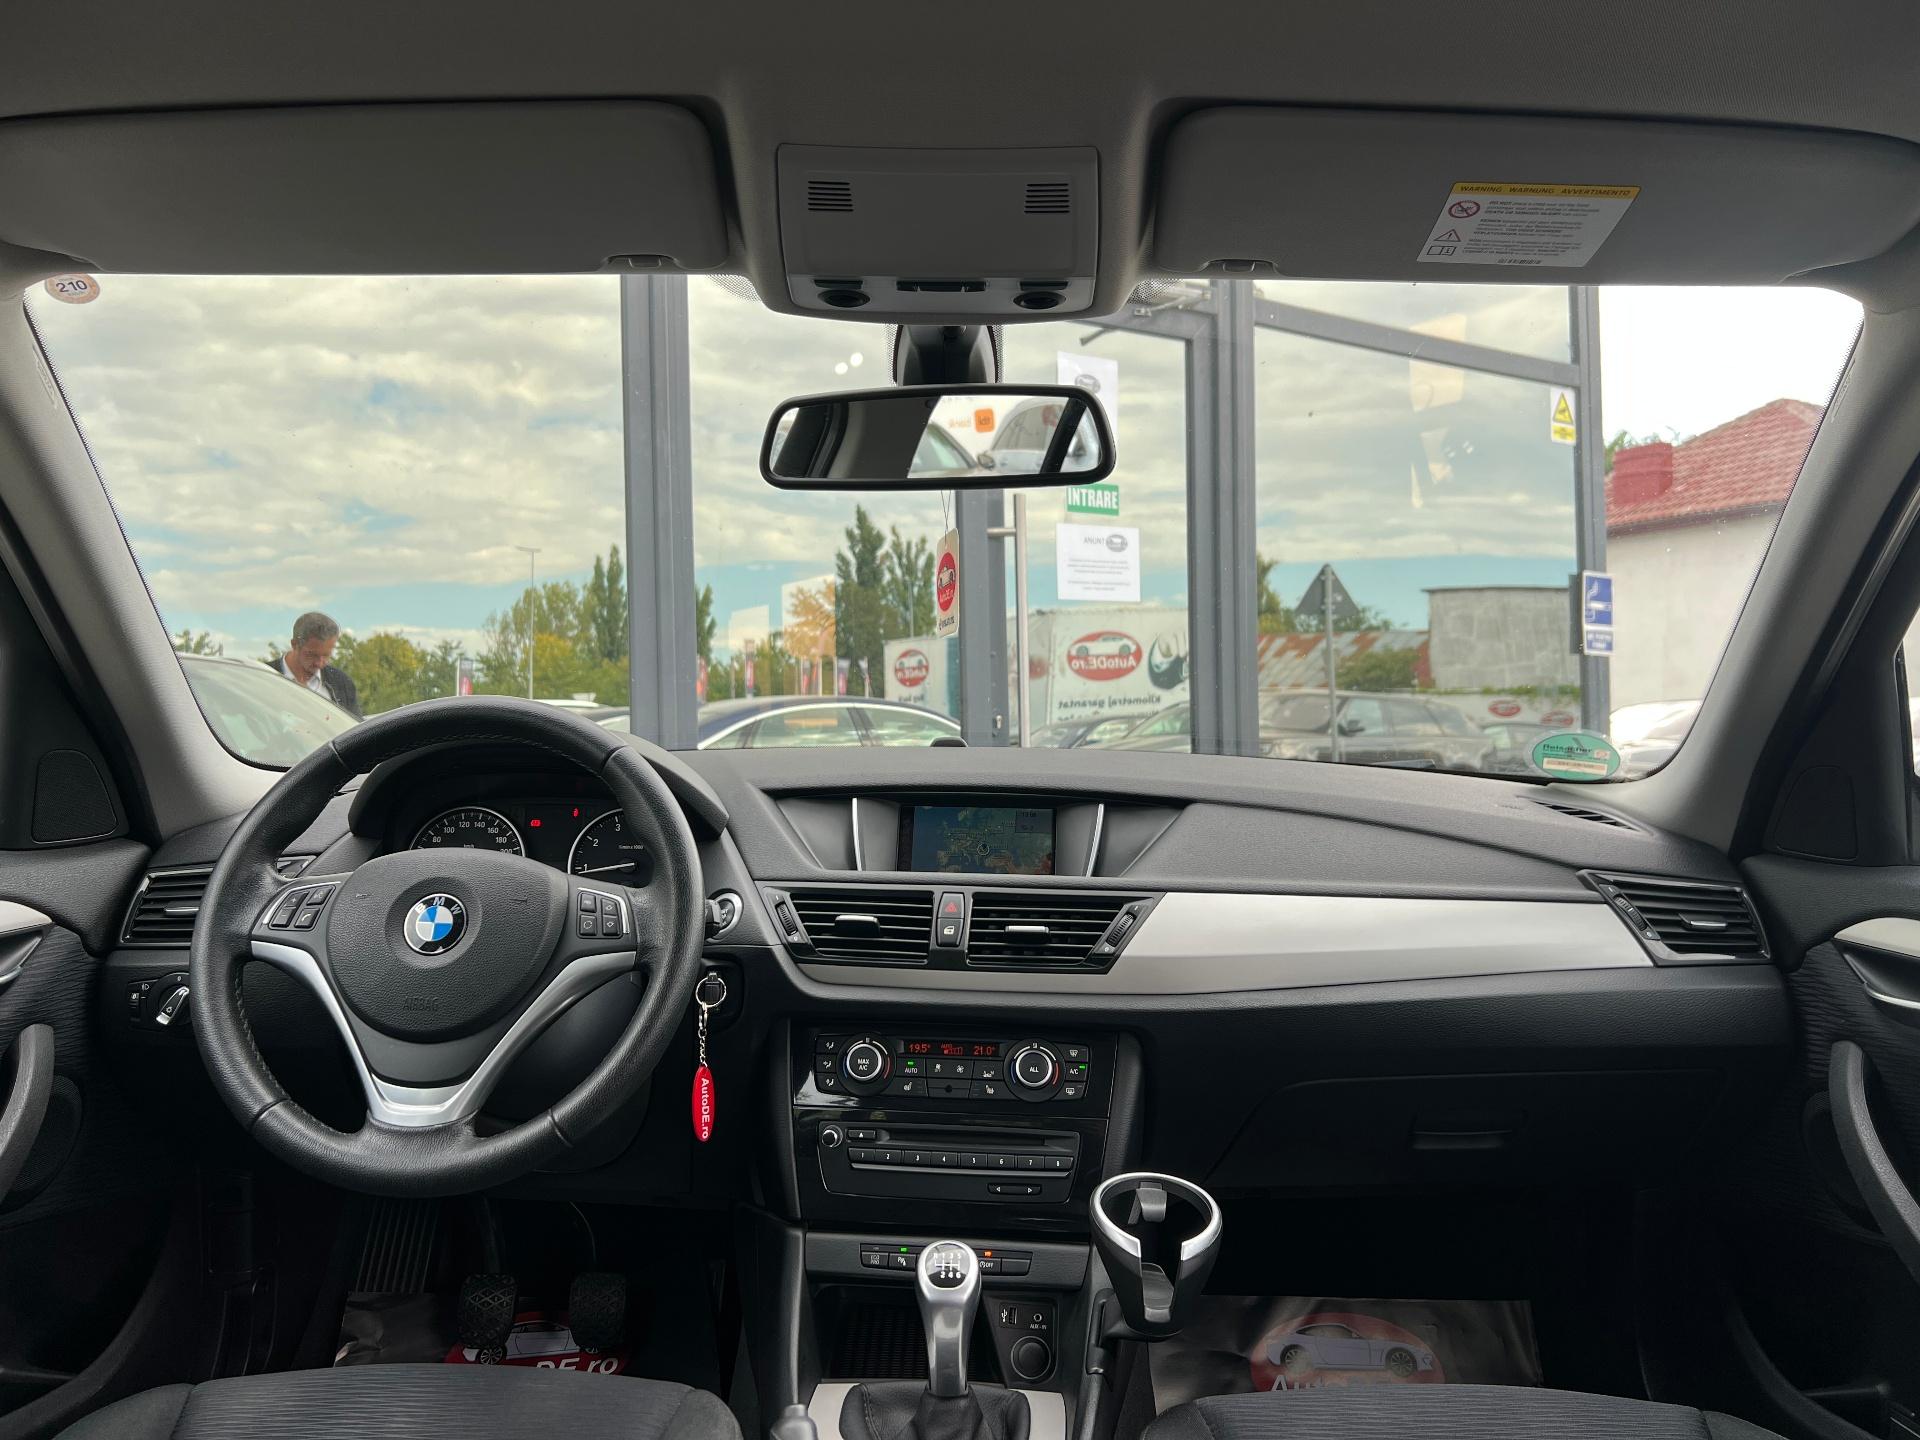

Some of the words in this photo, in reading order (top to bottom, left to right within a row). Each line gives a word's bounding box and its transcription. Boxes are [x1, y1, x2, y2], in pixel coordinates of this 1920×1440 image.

[1561, 188, 1631, 196] AVVERTIMENTO
[56, 280, 88, 292] 210
[1067, 487, 1118, 509] INTRARE
[592, 839, 599, 847] 2
[583, 864, 588, 872] 1
[415, 896, 462, 915] BMW
[700, 1077, 710, 1139] AutoDE.ro
